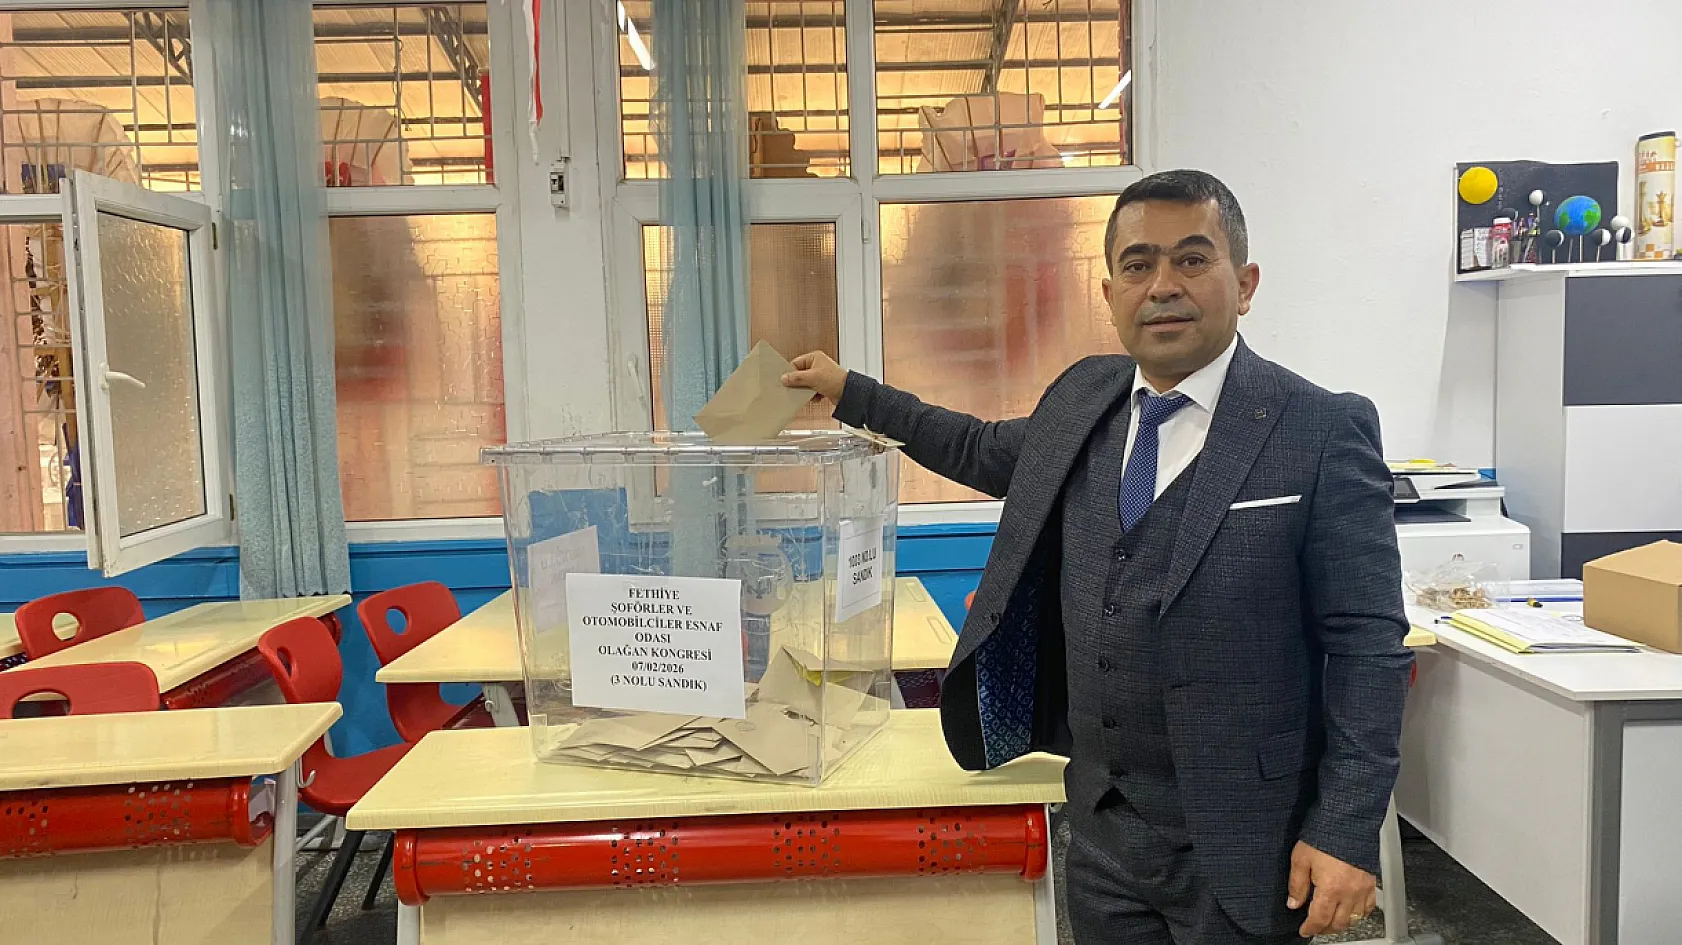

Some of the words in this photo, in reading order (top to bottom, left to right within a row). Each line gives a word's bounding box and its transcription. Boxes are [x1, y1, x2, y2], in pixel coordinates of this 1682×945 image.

[852, 566, 873, 585] SANDIK
[628, 587, 680, 600] FETHİYE
[611, 602, 675, 615] ŞOFÖRLER
[677, 605, 693, 616] VE
[582, 615, 683, 630] OTOMOBİLCİLER
[686, 620, 723, 632] ESNAF
[634, 632, 671, 644] ODASI
[598, 644, 649, 657] OLAĞAN
[651, 648, 712, 661] KONGRESİ
[631, 662, 684, 674] 07/02/2026
[611, 674, 621, 686] (3
[623, 675, 655, 687] NOLU
[658, 678, 708, 691] SANDIK)
